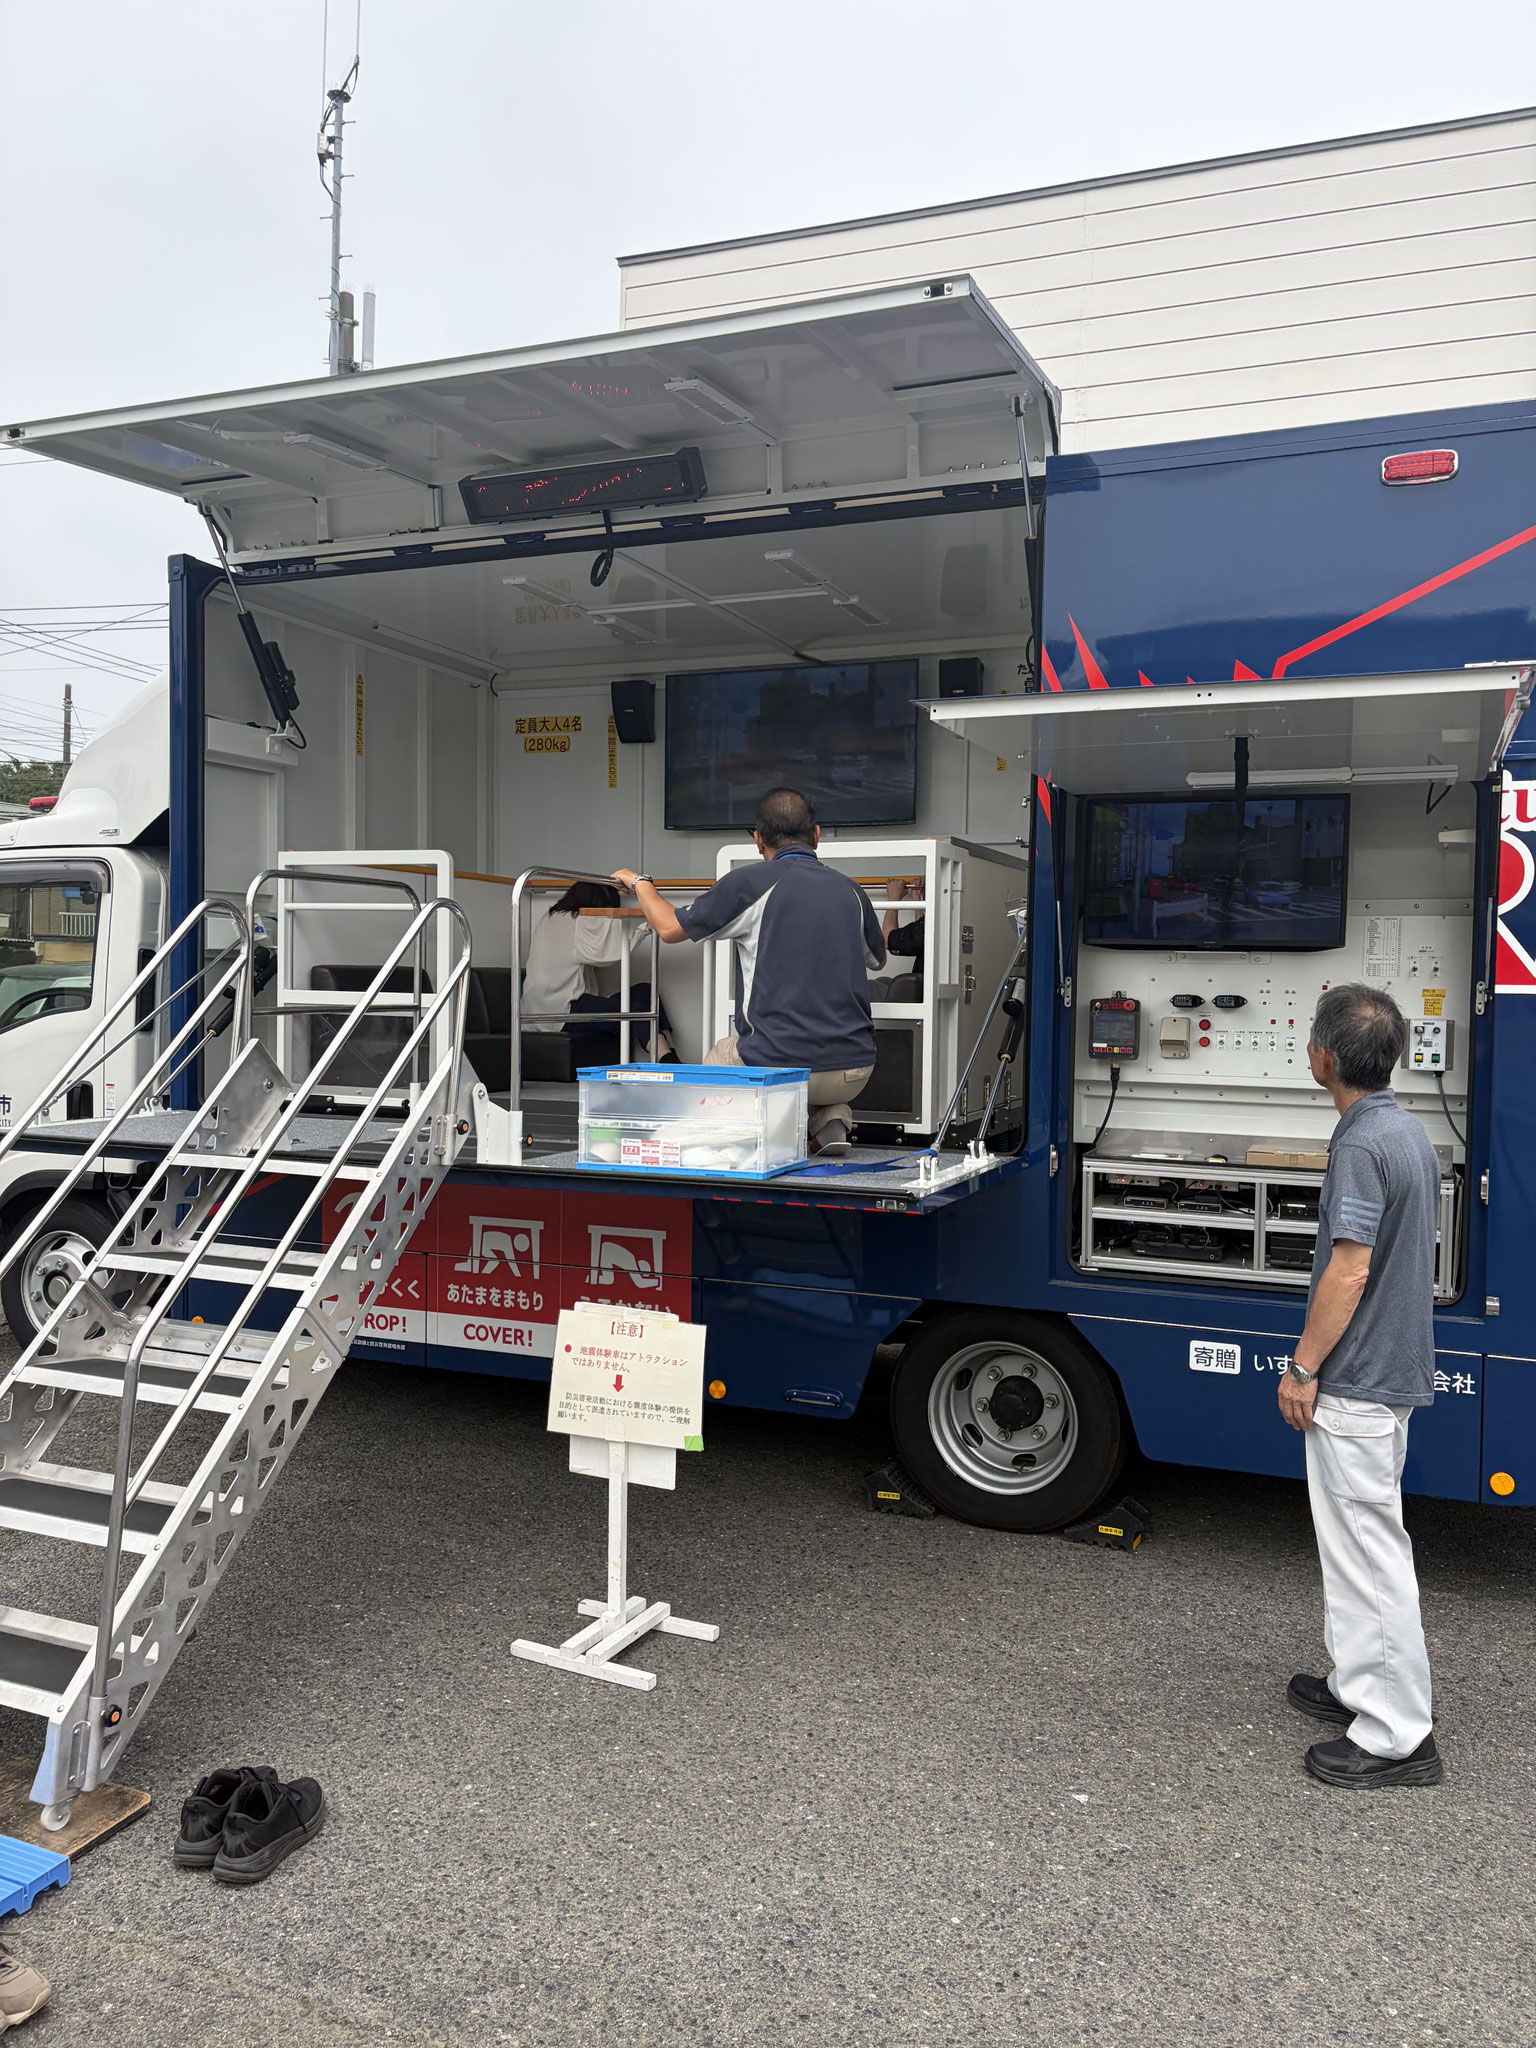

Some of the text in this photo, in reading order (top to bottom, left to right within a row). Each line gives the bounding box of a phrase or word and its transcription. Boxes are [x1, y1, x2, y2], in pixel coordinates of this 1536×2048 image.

[515, 716, 582, 734] 定員大人4名
[524, 736, 571, 753] (280kg)
[447, 1283, 544, 1312] あたまをまもり
[353, 1313, 407, 1333] ROP!
[610, 1322, 643, 1338] 【注意】
[463, 1323, 532, 1347] COVER!
[571, 1357, 631, 1373] ではありません。
[580, 1346, 688, 1367] 地震体験車はアトラクション
[1194, 1346, 1236, 1370] 寄贈
[557, 1411, 587, 1422] 願います。
